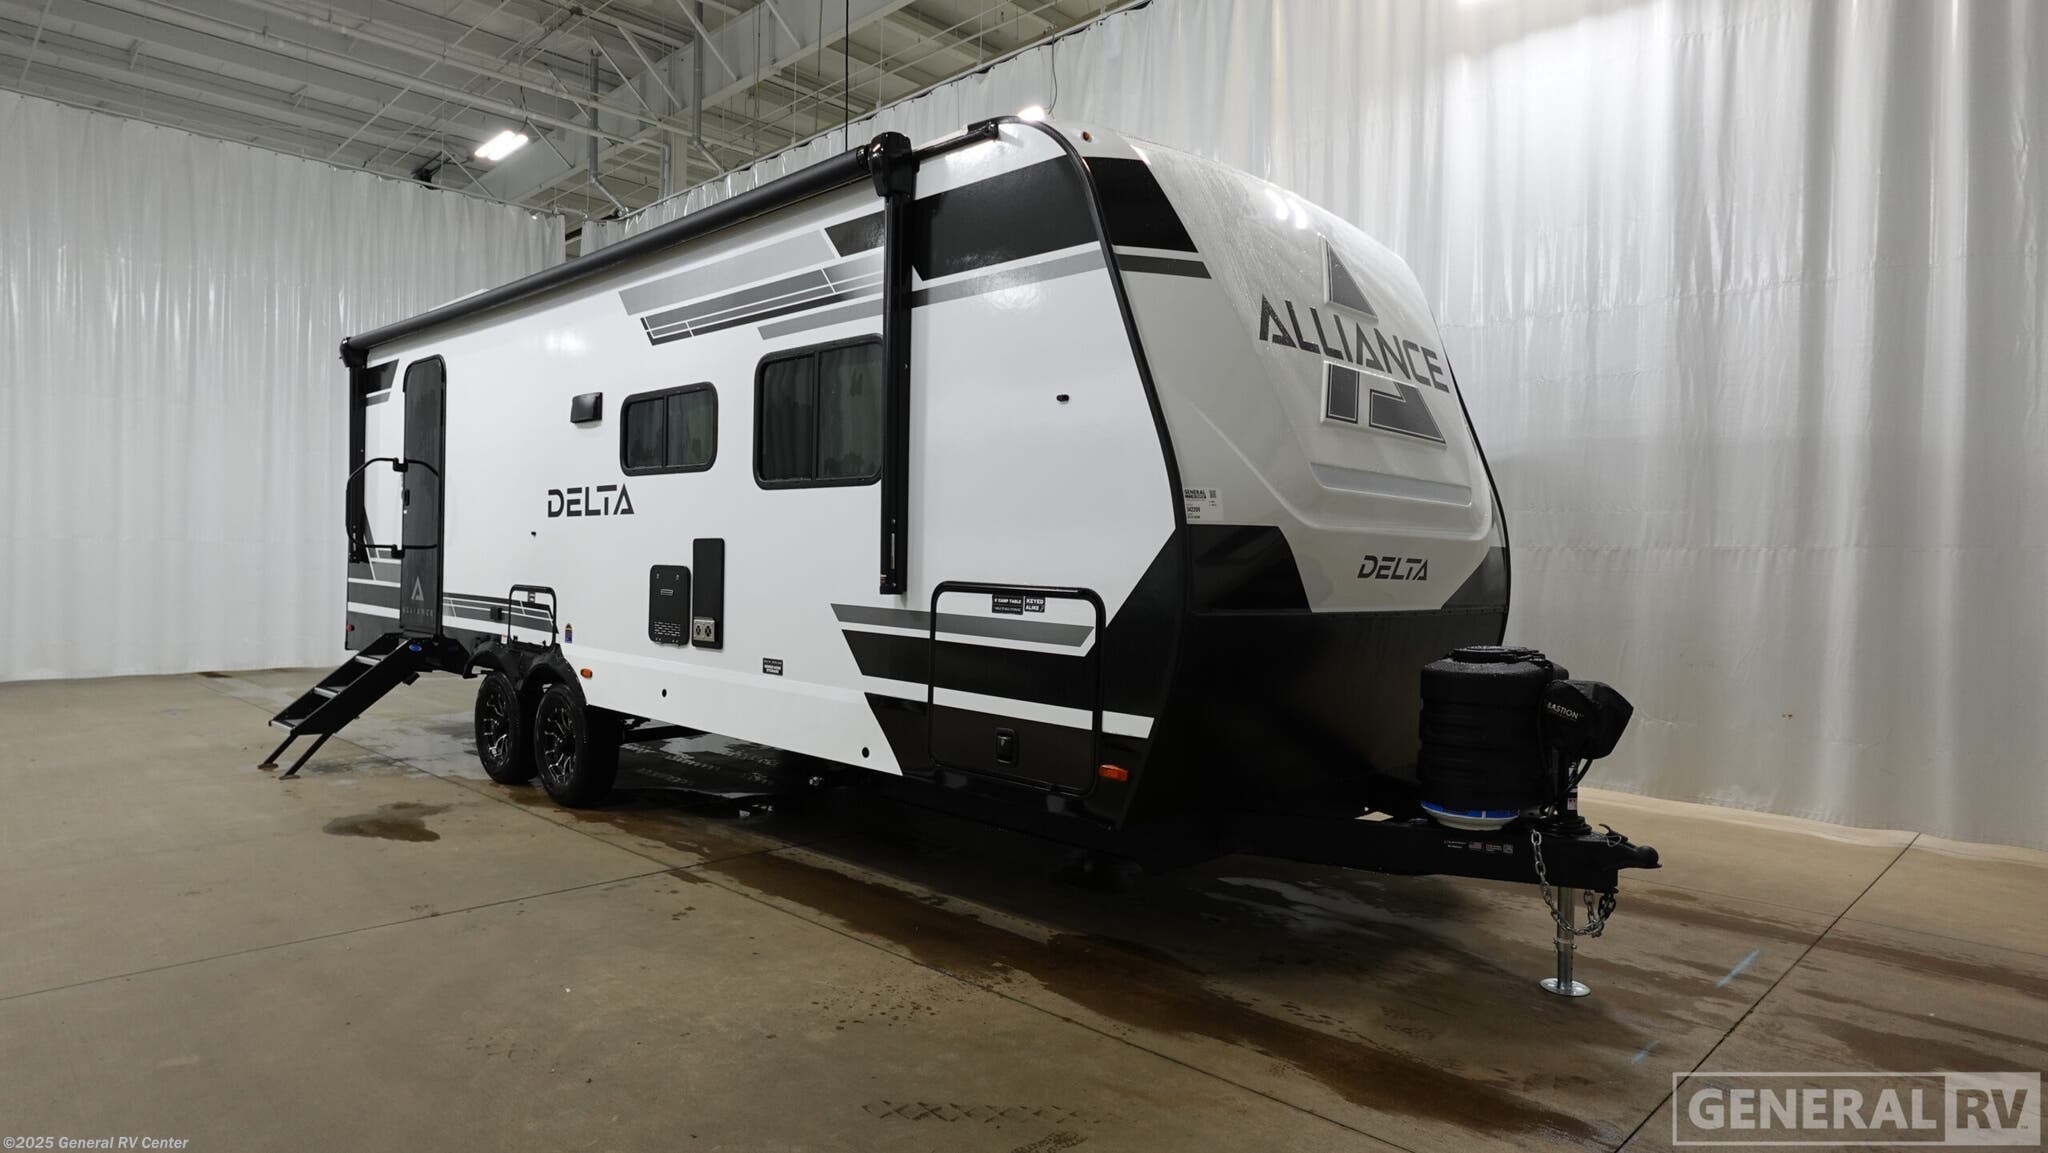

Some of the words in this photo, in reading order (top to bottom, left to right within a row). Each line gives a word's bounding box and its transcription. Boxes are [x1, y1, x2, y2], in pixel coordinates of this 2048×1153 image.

[1259, 294, 1450, 394] ALLIANCE
[548, 483, 635, 518] DELTA
[1357, 555, 1428, 581] DELTA
